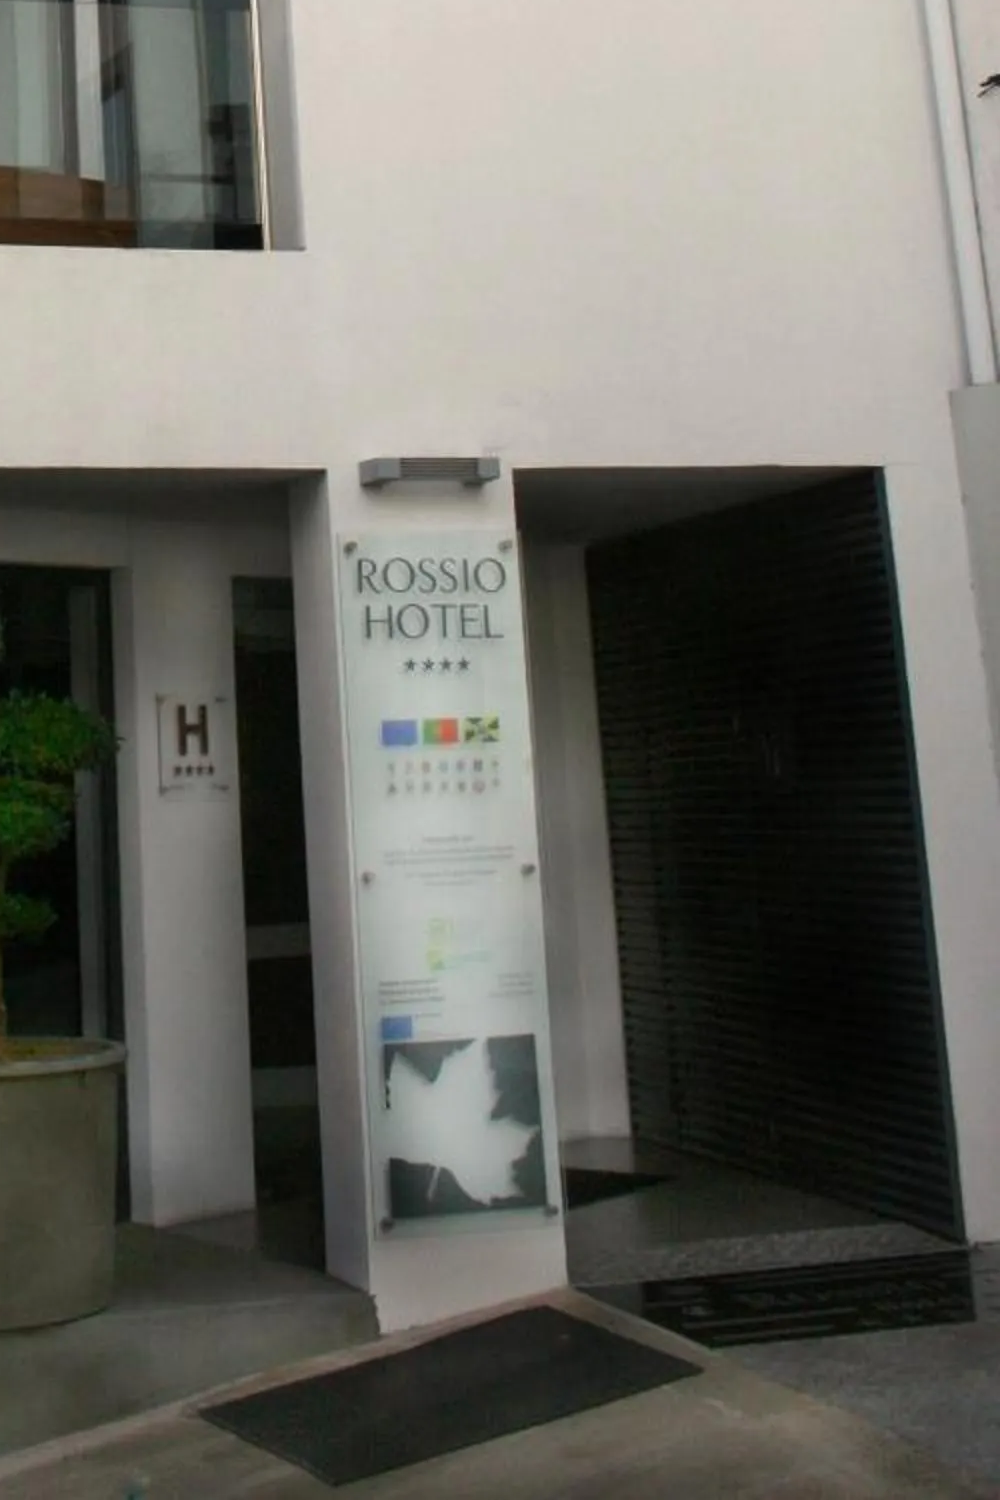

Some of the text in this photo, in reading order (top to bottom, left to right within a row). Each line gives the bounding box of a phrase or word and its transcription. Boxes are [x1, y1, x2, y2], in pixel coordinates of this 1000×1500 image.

[356, 557, 507, 594] ROSSIO
[364, 603, 505, 640] HOTEL
[177, 704, 209, 757] H
